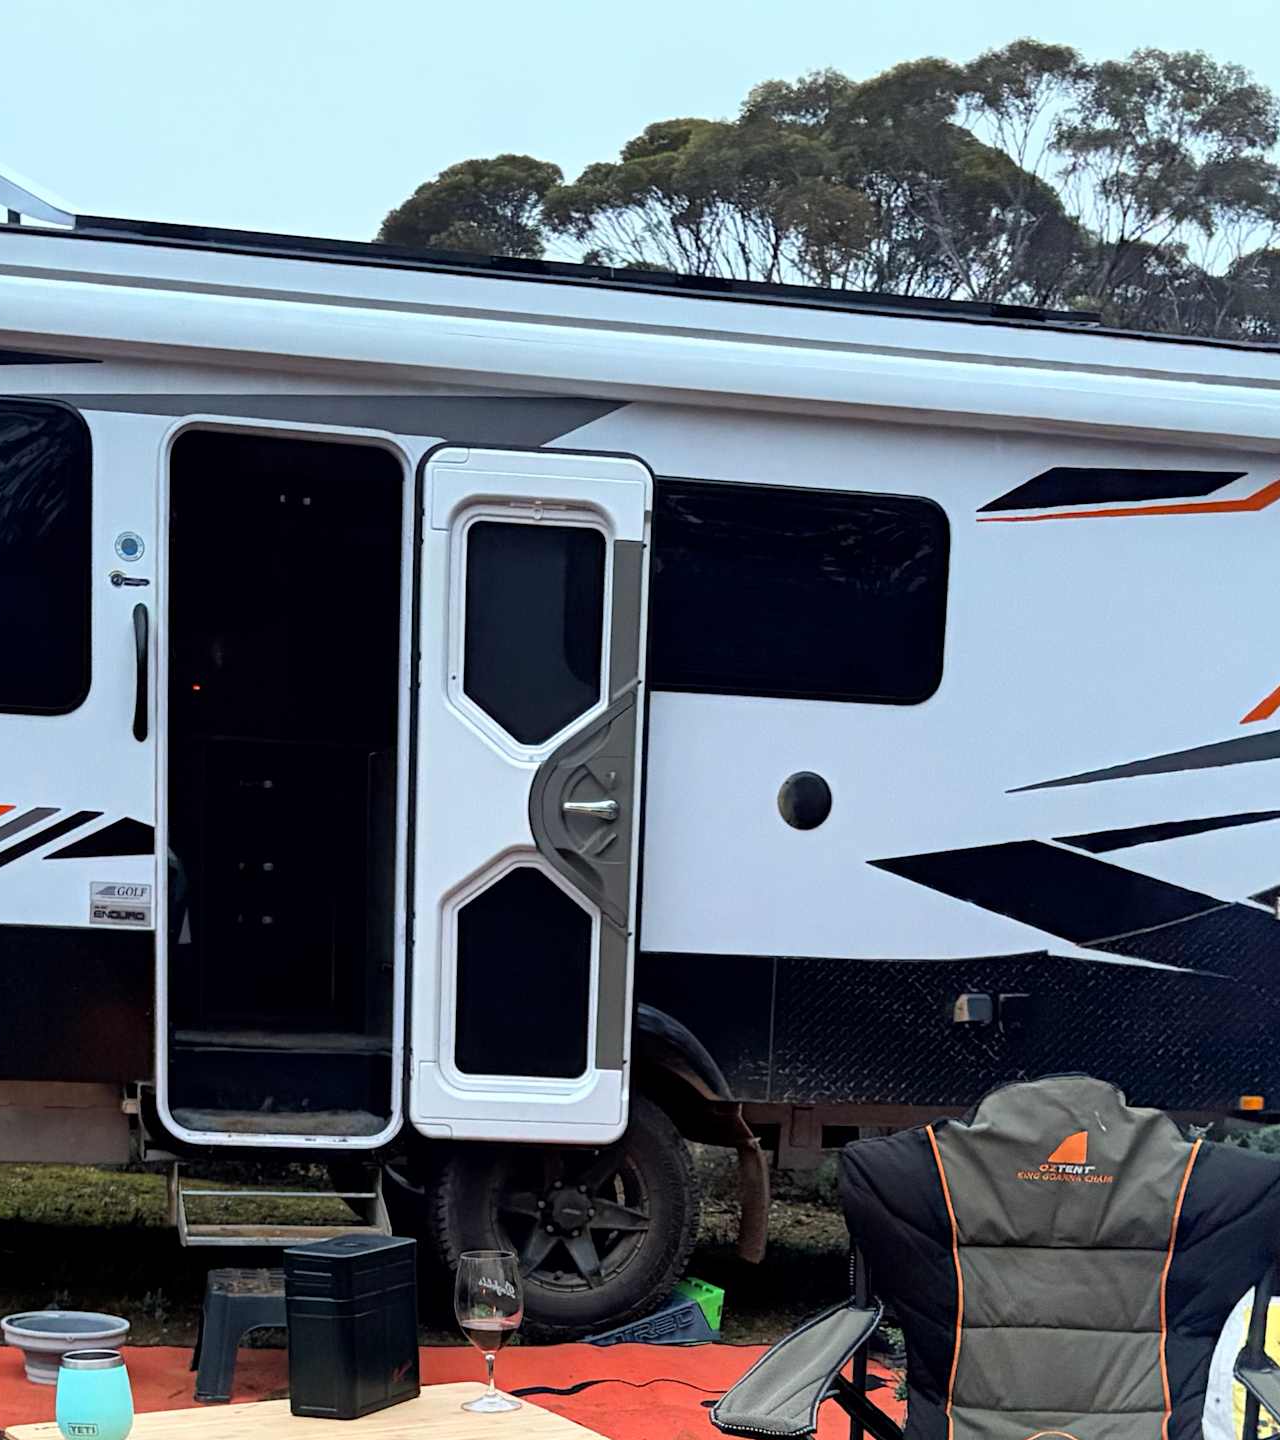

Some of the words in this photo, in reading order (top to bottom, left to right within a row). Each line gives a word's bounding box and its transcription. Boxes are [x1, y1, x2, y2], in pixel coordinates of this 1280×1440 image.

[117, 886, 148, 897] GOLF
[93, 909, 146, 921] ENDURO
[70, 1425, 96, 1434] YETI
